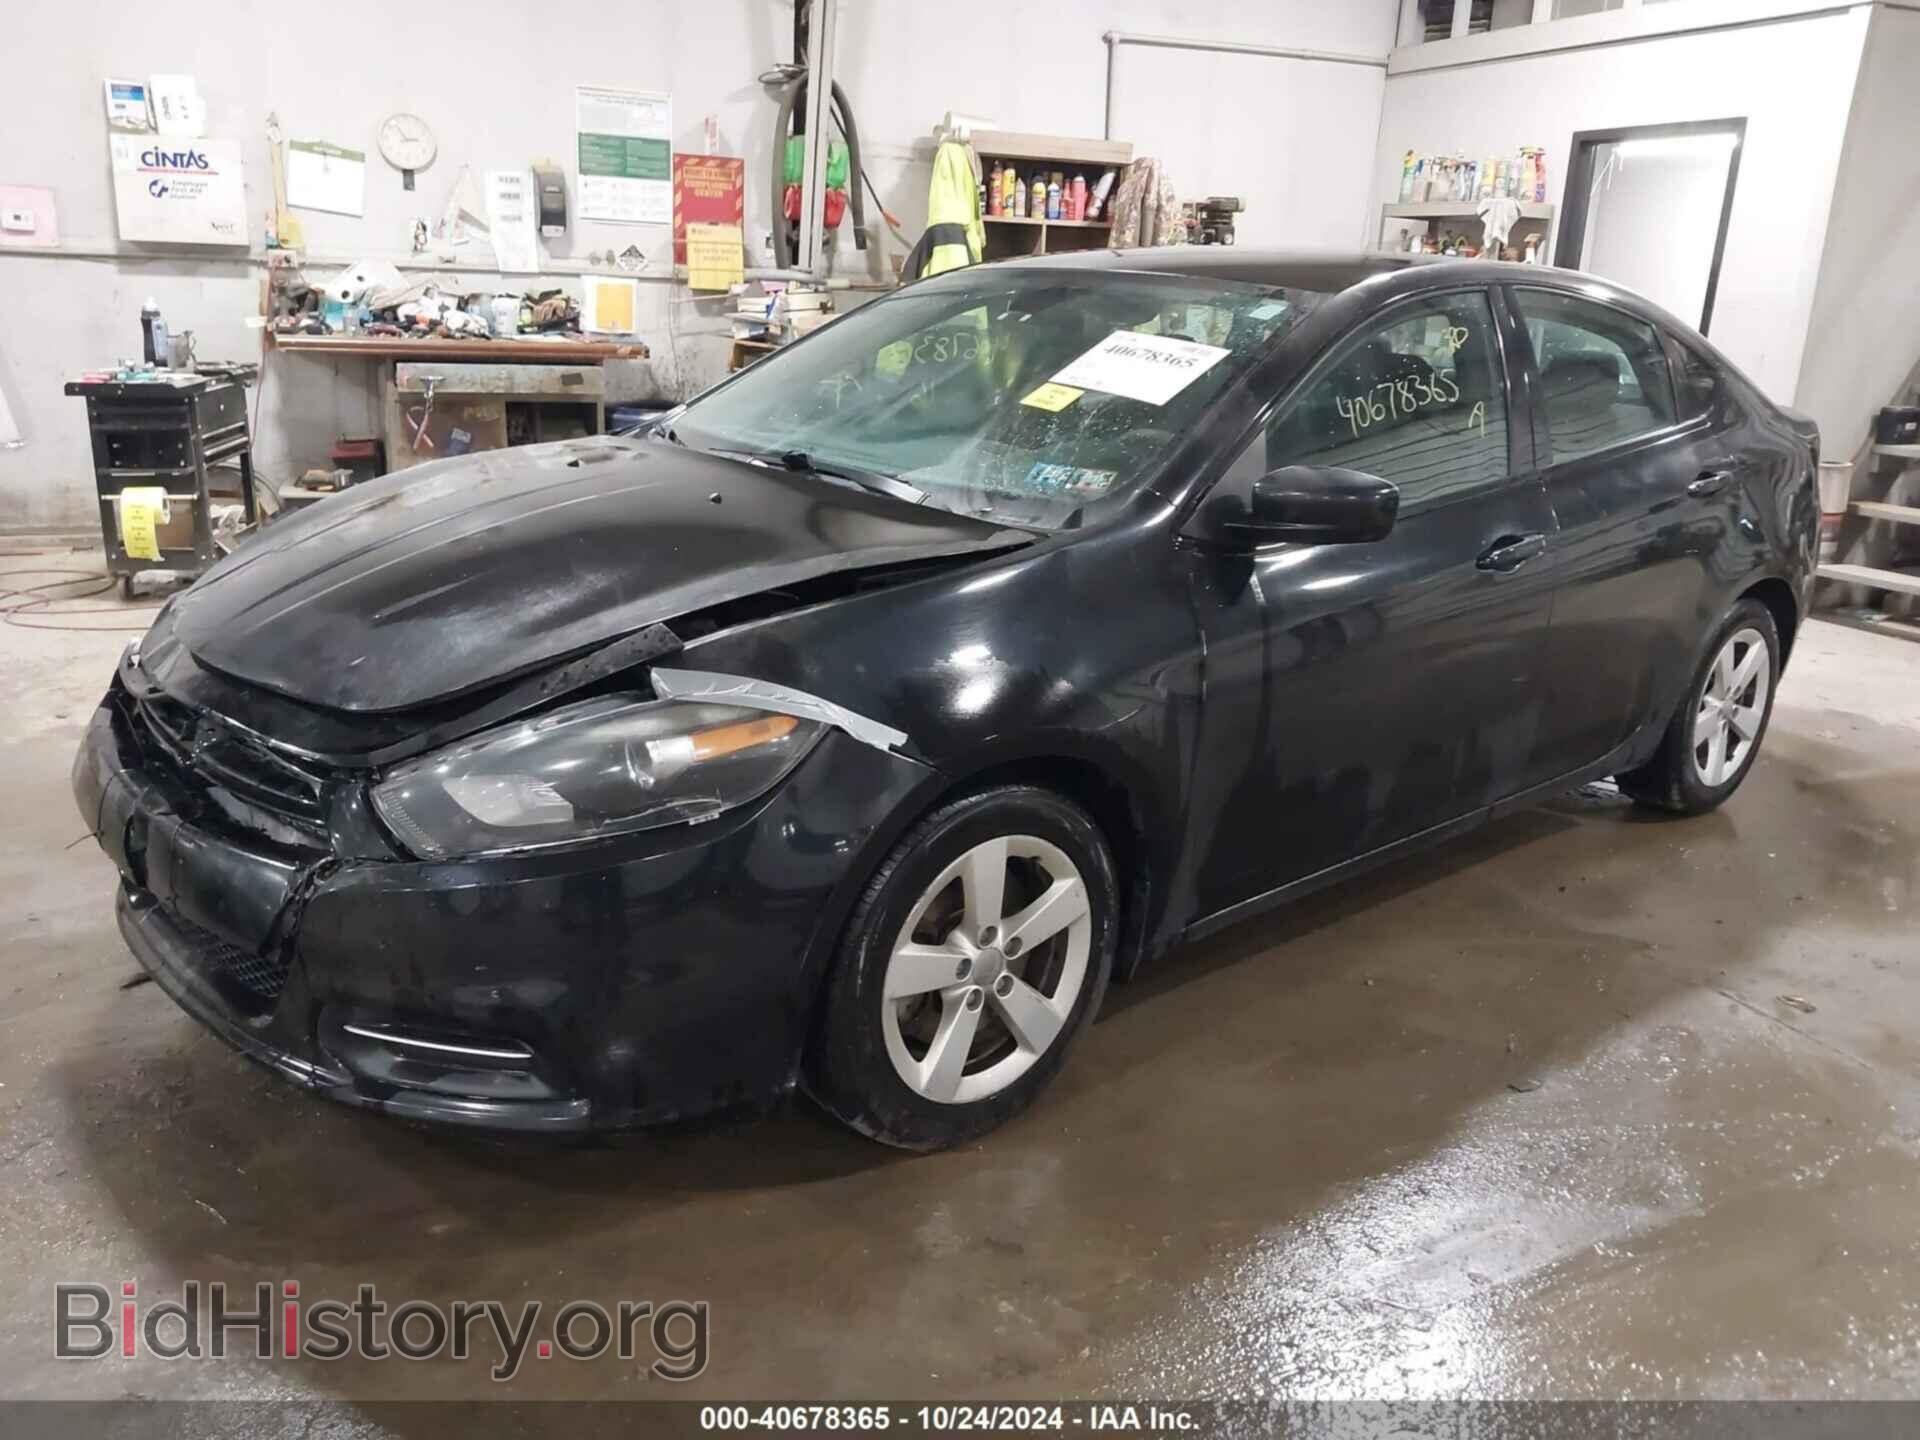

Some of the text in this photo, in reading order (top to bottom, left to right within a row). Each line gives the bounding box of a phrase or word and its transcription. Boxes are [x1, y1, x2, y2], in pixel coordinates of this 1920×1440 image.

[141, 146, 209, 170] CINTAS
[1104, 344, 1198, 368] 40678365
[1336, 368, 1460, 439] 40678365
